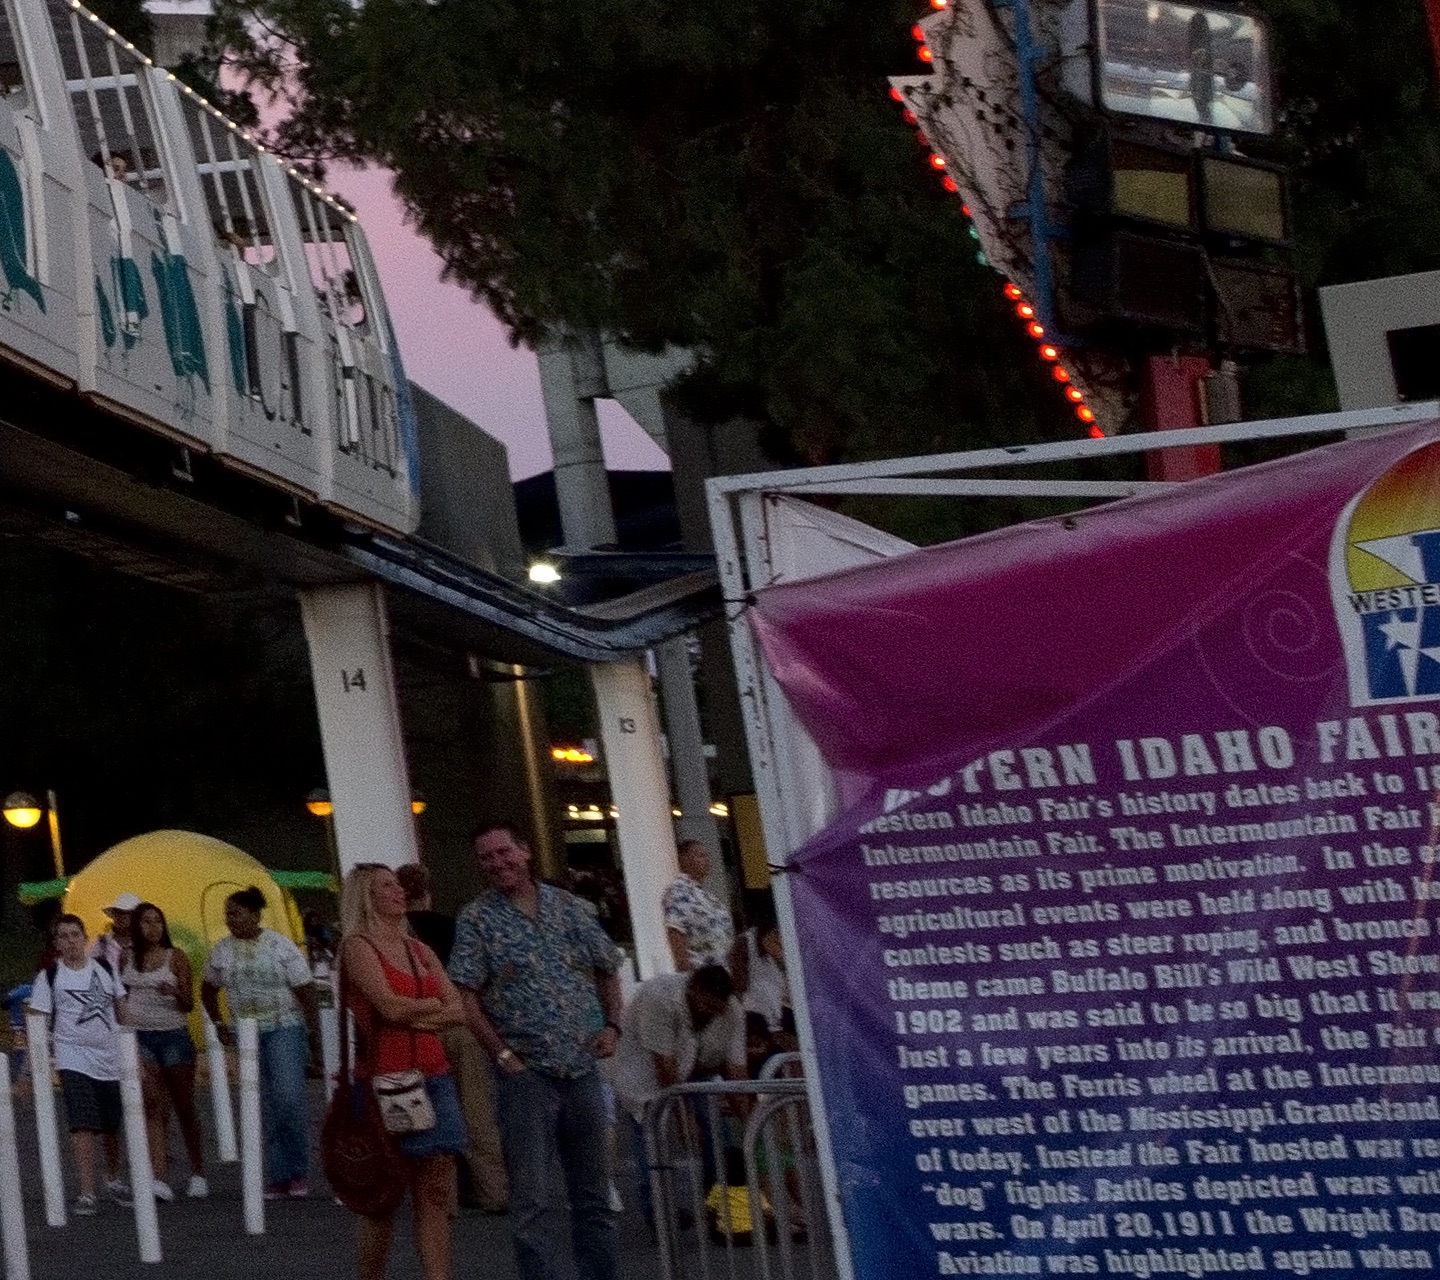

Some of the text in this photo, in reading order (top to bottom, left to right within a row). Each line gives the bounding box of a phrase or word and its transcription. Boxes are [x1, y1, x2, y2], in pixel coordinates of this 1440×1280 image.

[1347, 584, 1440, 613] WESTE
[340, 667, 367, 693] 14
[1116, 725, 1294, 781] IDAHO
[1316, 711, 1440, 763] FAIR
[957, 801, 1034, 827] Idaho
[1037, 794, 1114, 822] Fair's
[1119, 791, 1216, 815] history
[1225, 783, 1301, 807] dates
[1303, 772, 1367, 800] back
[1373, 770, 1405, 794] to
[860, 835, 1042, 867] Intermountain
[1110, 825, 1166, 851] The
[1169, 810, 1358, 847] Intermountain
[1362, 804, 1422, 831] Fair
[869, 875, 993, 900] resources
[999, 874, 1031, 892] as
[1035, 867, 1073, 891] its
[1078, 864, 1158, 893] prime
[1322, 846, 1355, 870] In
[1362, 842, 1412, 868] the
[878, 903, 1027, 938] agricultural
[1032, 900, 1120, 926] events
[1126, 898, 1194, 920] were
[1197, 889, 1257, 916] held
[1260, 886, 1333, 913] along
[1338, 877, 1407, 905] with
[884, 941, 993, 967] contests
[998, 935, 1062, 962] such
[1068, 939, 1101, 958] as
[1105, 932, 1175, 957] steer
[1274, 918, 1328, 945] and
[1333, 917, 1430, 942] bronco
[887, 977, 970, 1001] theme
[976, 977, 1048, 998] came
[1051, 965, 1149, 993] Buffalo
[1225, 957, 1282, 983] Wild
[1286, 954, 1364, 981] West
[894, 1008, 965, 1035] 1902
[971, 1006, 1022, 1032] and
[1026, 1009, 1082, 1031] was
[1085, 1000, 1146, 1028] said
[1150, 1001, 1181, 1025] to
[1184, 998, 1215, 1023] be
[1218, 1000, 1251, 1021] so
[1254, 993, 1305, 1024] big
[1309, 990, 1372, 1016] that
[1376, 987, 1400, 1012] it
[955, 1048, 975, 1068] a
[981, 1042, 1029, 1067] few
[1034, 1043, 1112, 1071] years
[1116, 1037, 1171, 1061] into
[1176, 1035, 1206, 1058] its
[1320, 1026, 1371, 1052] the
[1376, 1022, 1428, 1049] Fair
[1000, 1074, 1058, 1101] The
[1061, 1073, 1143, 1099] Ferris
[1147, 1067, 1219, 1096] wheel
[1226, 1067, 1257, 1092] at
[1262, 1064, 1313, 1091] the
[909, 1117, 967, 1138] ever
[971, 1113, 1038, 1136] west
[1042, 1109, 1072, 1135] of
[1078, 1108, 1125, 1134] the
[915, 1147, 944, 1173] of
[1036, 1141, 1132, 1169] Instead
[1136, 1141, 1180, 1167] the
[1186, 1139, 1242, 1165] Fair
[1248, 1134, 1349, 1163] hosted
[1354, 1139, 1405, 1159] war
[1094, 1176, 1187, 1203] Battles
[1193, 1171, 1319, 1206] depicted
[1324, 1175, 1393, 1195] wars
[1010, 1213, 1046, 1240] On
[1051, 1213, 1109, 1245] April
[1243, 1209, 1295, 1235] the
[1298, 1205, 1394, 1239] Wright
[936, 1243, 1433, 1279] Aviation was highlighted again when
